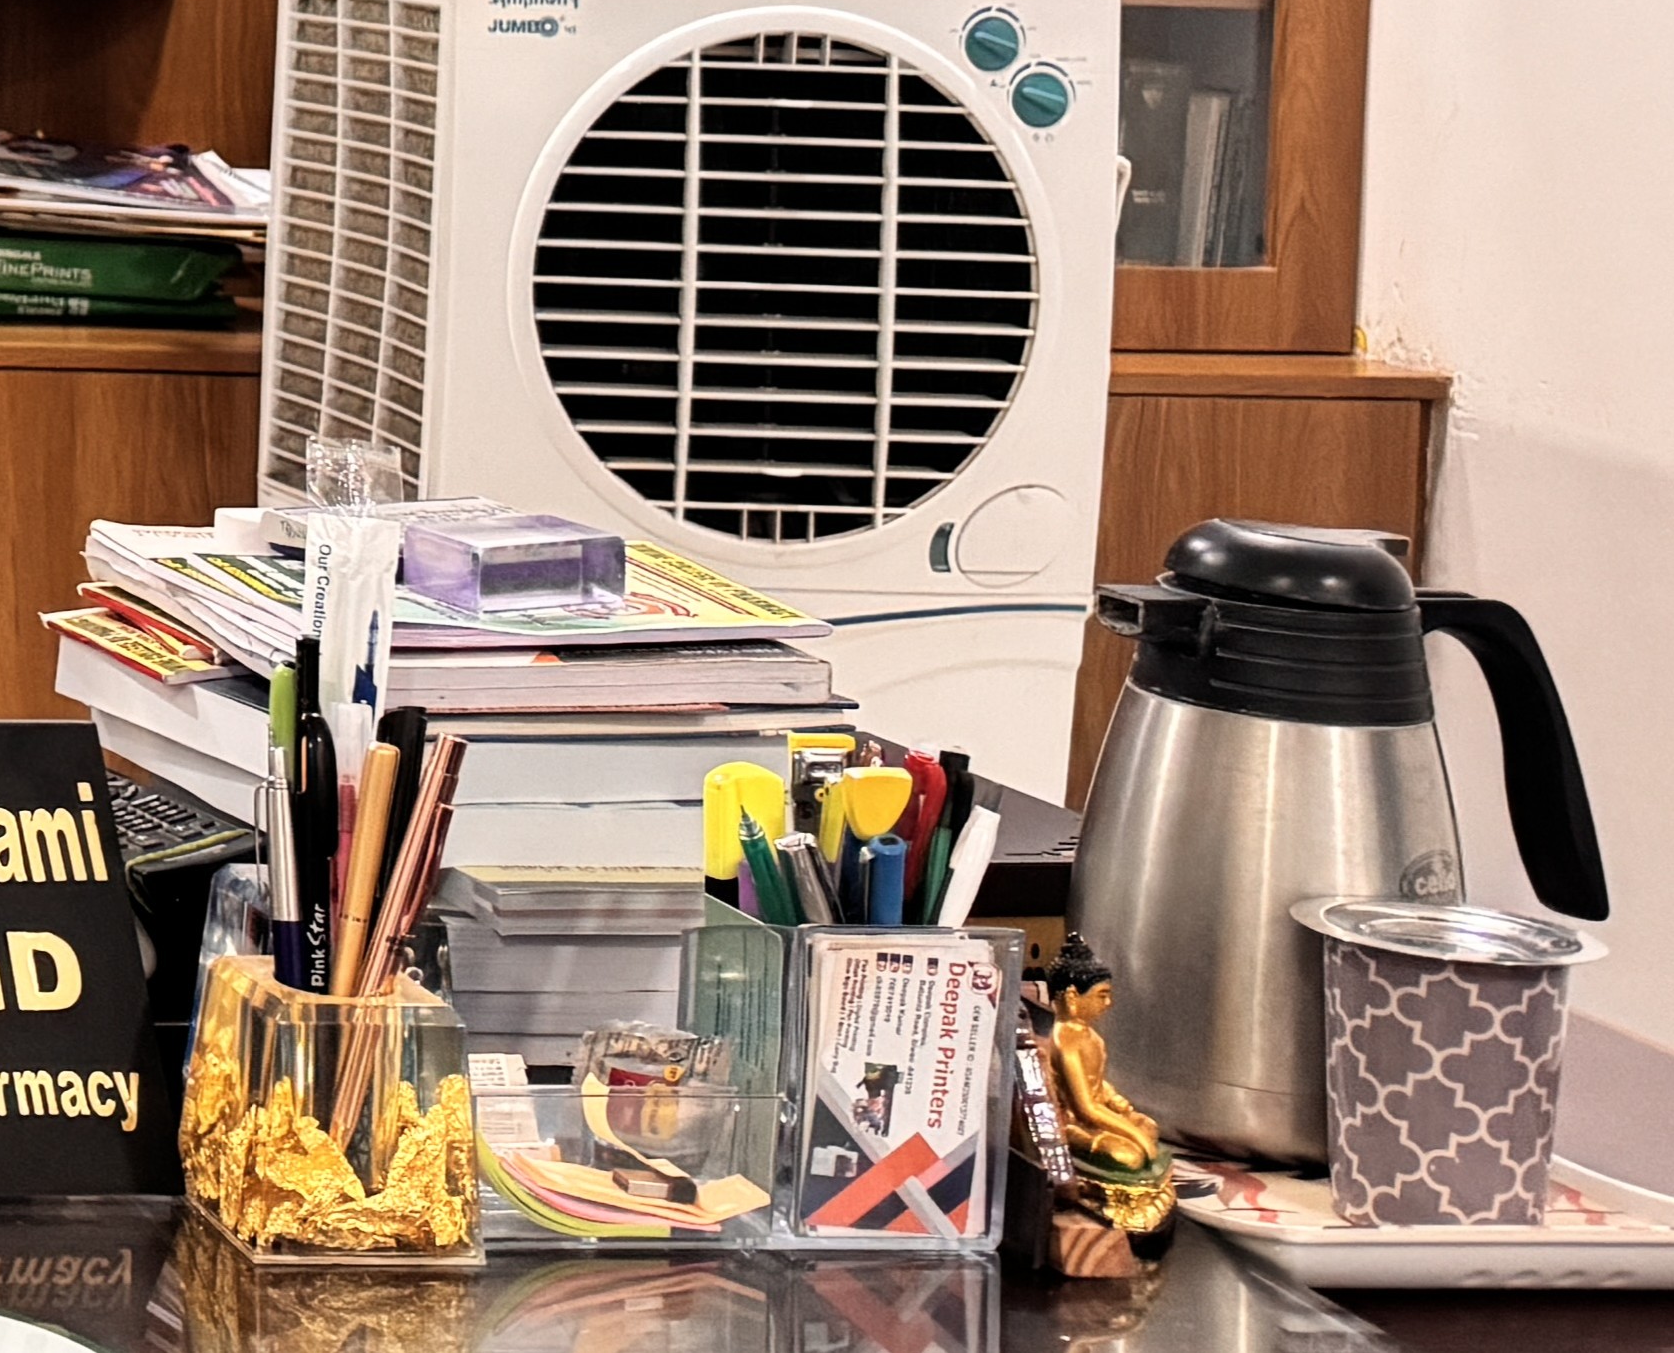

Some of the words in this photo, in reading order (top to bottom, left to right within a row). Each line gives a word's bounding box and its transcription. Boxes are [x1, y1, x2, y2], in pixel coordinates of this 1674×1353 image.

[488, 17, 559, 38] JUMBO
[317, 544, 332, 571] Our
[306, 903, 326, 946] Star
[311, 949, 326, 987] Pink
[939, 963, 966, 1040] Deepak
[927, 1046, 956, 1129] Printers
